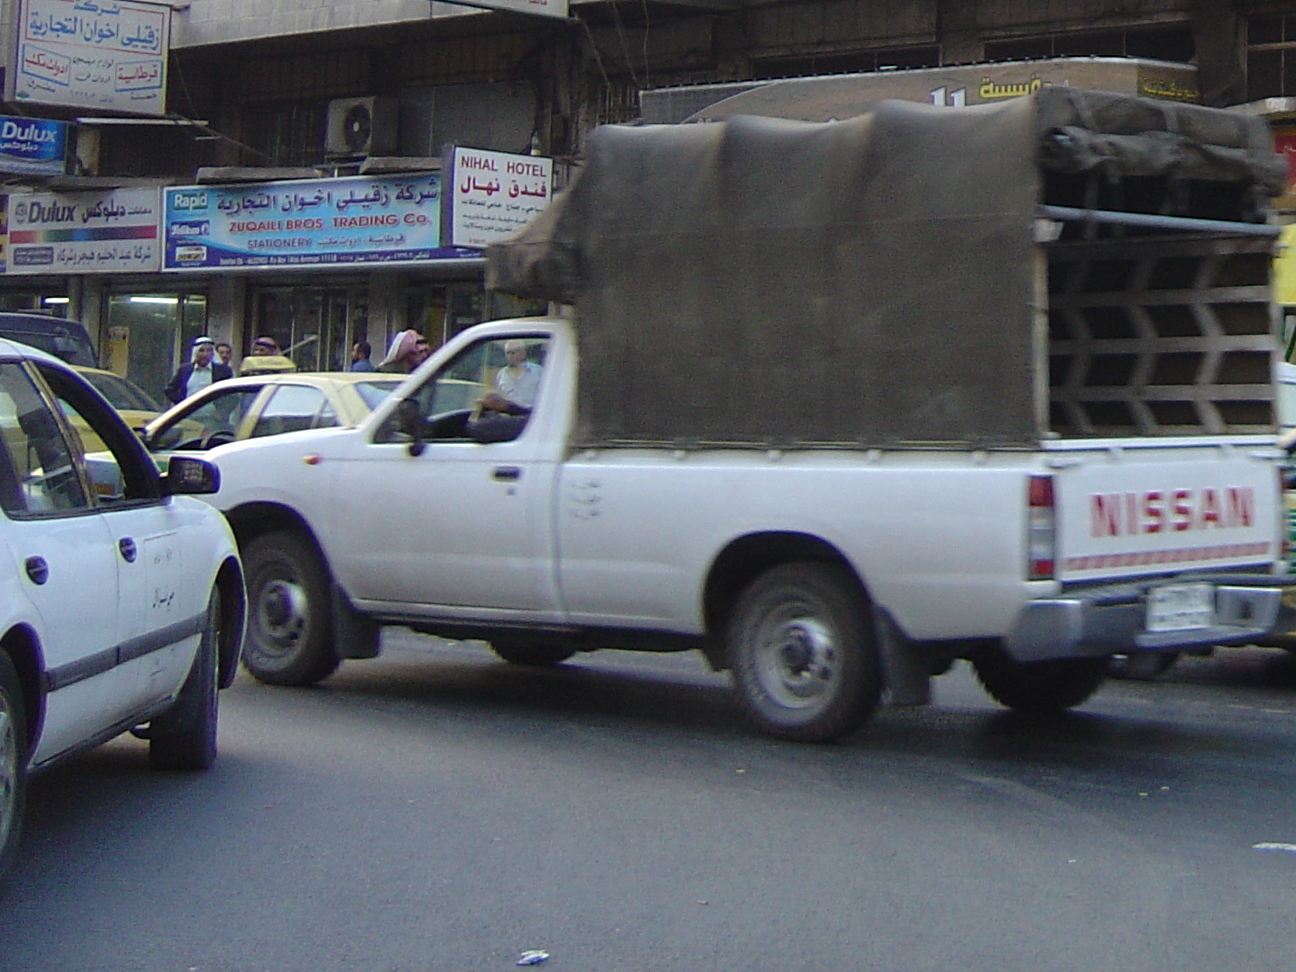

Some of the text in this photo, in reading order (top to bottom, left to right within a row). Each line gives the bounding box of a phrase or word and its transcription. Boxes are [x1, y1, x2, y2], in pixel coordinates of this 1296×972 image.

[29, 11, 83, 38] التجارية
[83, 19, 120, 44] اخوان
[2, 121, 58, 143] Dulux
[461, 155, 547, 178] NIHAL HOTEL
[216, 178, 438, 216] شركة زقيلي اخوان التجارية
[460, 174, 547, 198] فندق نهال
[28, 199, 77, 224] Dulux
[81, 198, 126, 224] ديلوكس
[174, 193, 209, 212] Rapid
[228, 219, 282, 233] ZUQAILI
[332, 214, 398, 228] TRADING
[247, 237, 312, 251] STATIONERY
[1091, 486, 1255, 539] NISSAN
